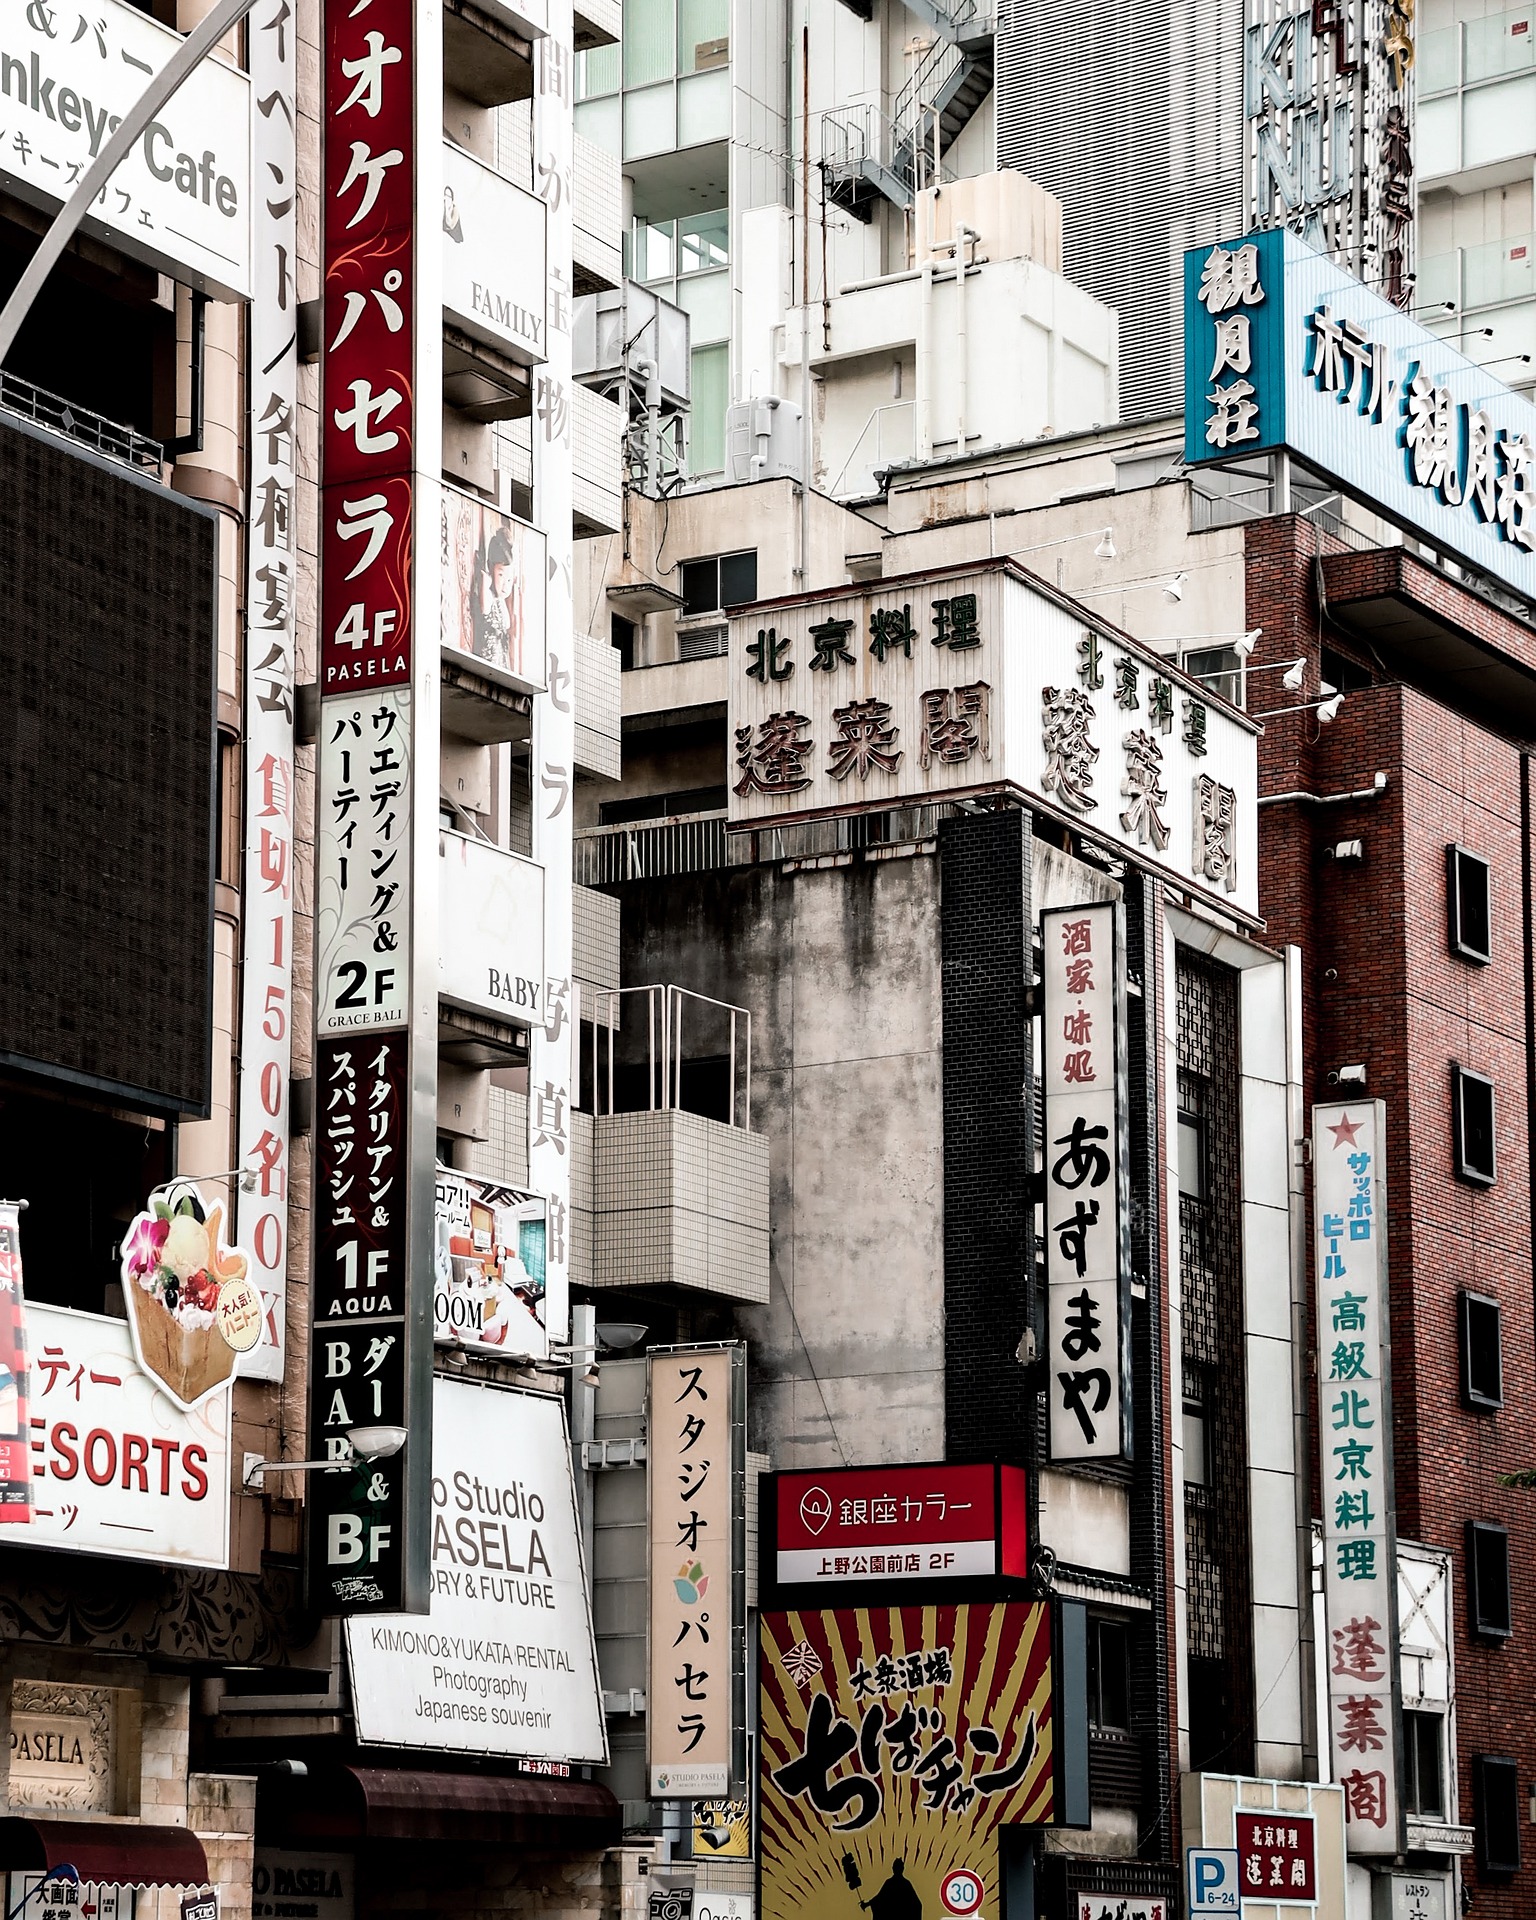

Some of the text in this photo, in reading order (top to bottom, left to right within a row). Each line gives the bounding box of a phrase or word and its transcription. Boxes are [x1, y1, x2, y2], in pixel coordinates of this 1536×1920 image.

[144, 121, 238, 218] Cafe
[331, 0, 405, 581] オケパセラ
[471, 280, 542, 344] FAMILY
[1198, 243, 1265, 448] 観月荘
[334, 602, 396, 650] 4F
[746, 593, 983, 684] 北京料理
[327, 656, 406, 682] PASELA
[1076, 631, 1207, 757] 北京料理
[330, 712, 362, 891] パーティー
[335, 960, 396, 1010] 2F
[488, 967, 541, 1010] BABY
[328, 1009, 402, 1028] GRACE BALI
[326, 1051, 357, 1227] スパニッシュ
[1347, 1152, 1373, 1240] サッポロ
[335, 1240, 390, 1290] 1F
[1323, 1213, 1346, 1279] ビール
[222, 1290, 252, 1318] 大人気!
[328, 1295, 393, 1316] AQUA
[1051, 1117, 1111, 1444] あずまや
[435, 1293, 483, 1331] OOM
[1329, 1291, 1377, 1581] 高級北京料理
[454, 1470, 544, 1523] Studio
[839, 1492, 973, 1527] 銀座カラー
[327, 1513, 391, 1565] BF
[672, 1367, 711, 1754] スタジオ パセラ
[817, 1552, 955, 1576] 上野公園前店 2F
[371, 1627, 575, 1674] KIMONO&YUKATA RENTAL
[849, 1648, 952, 1699] 大衆酒場
[433, 1666, 528, 1703] Photography
[415, 1695, 552, 1729] Japanese souvenir
[772, 1692, 1037, 1832] ちばチャン
[1252, 1826, 1298, 1849] 北京料理
[950, 1883, 975, 1902] 30
[1195, 1858, 1225, 1903] P
[1208, 1892, 1235, 1906] 6-24
[1405, 1884, 1430, 1897] レストラン
